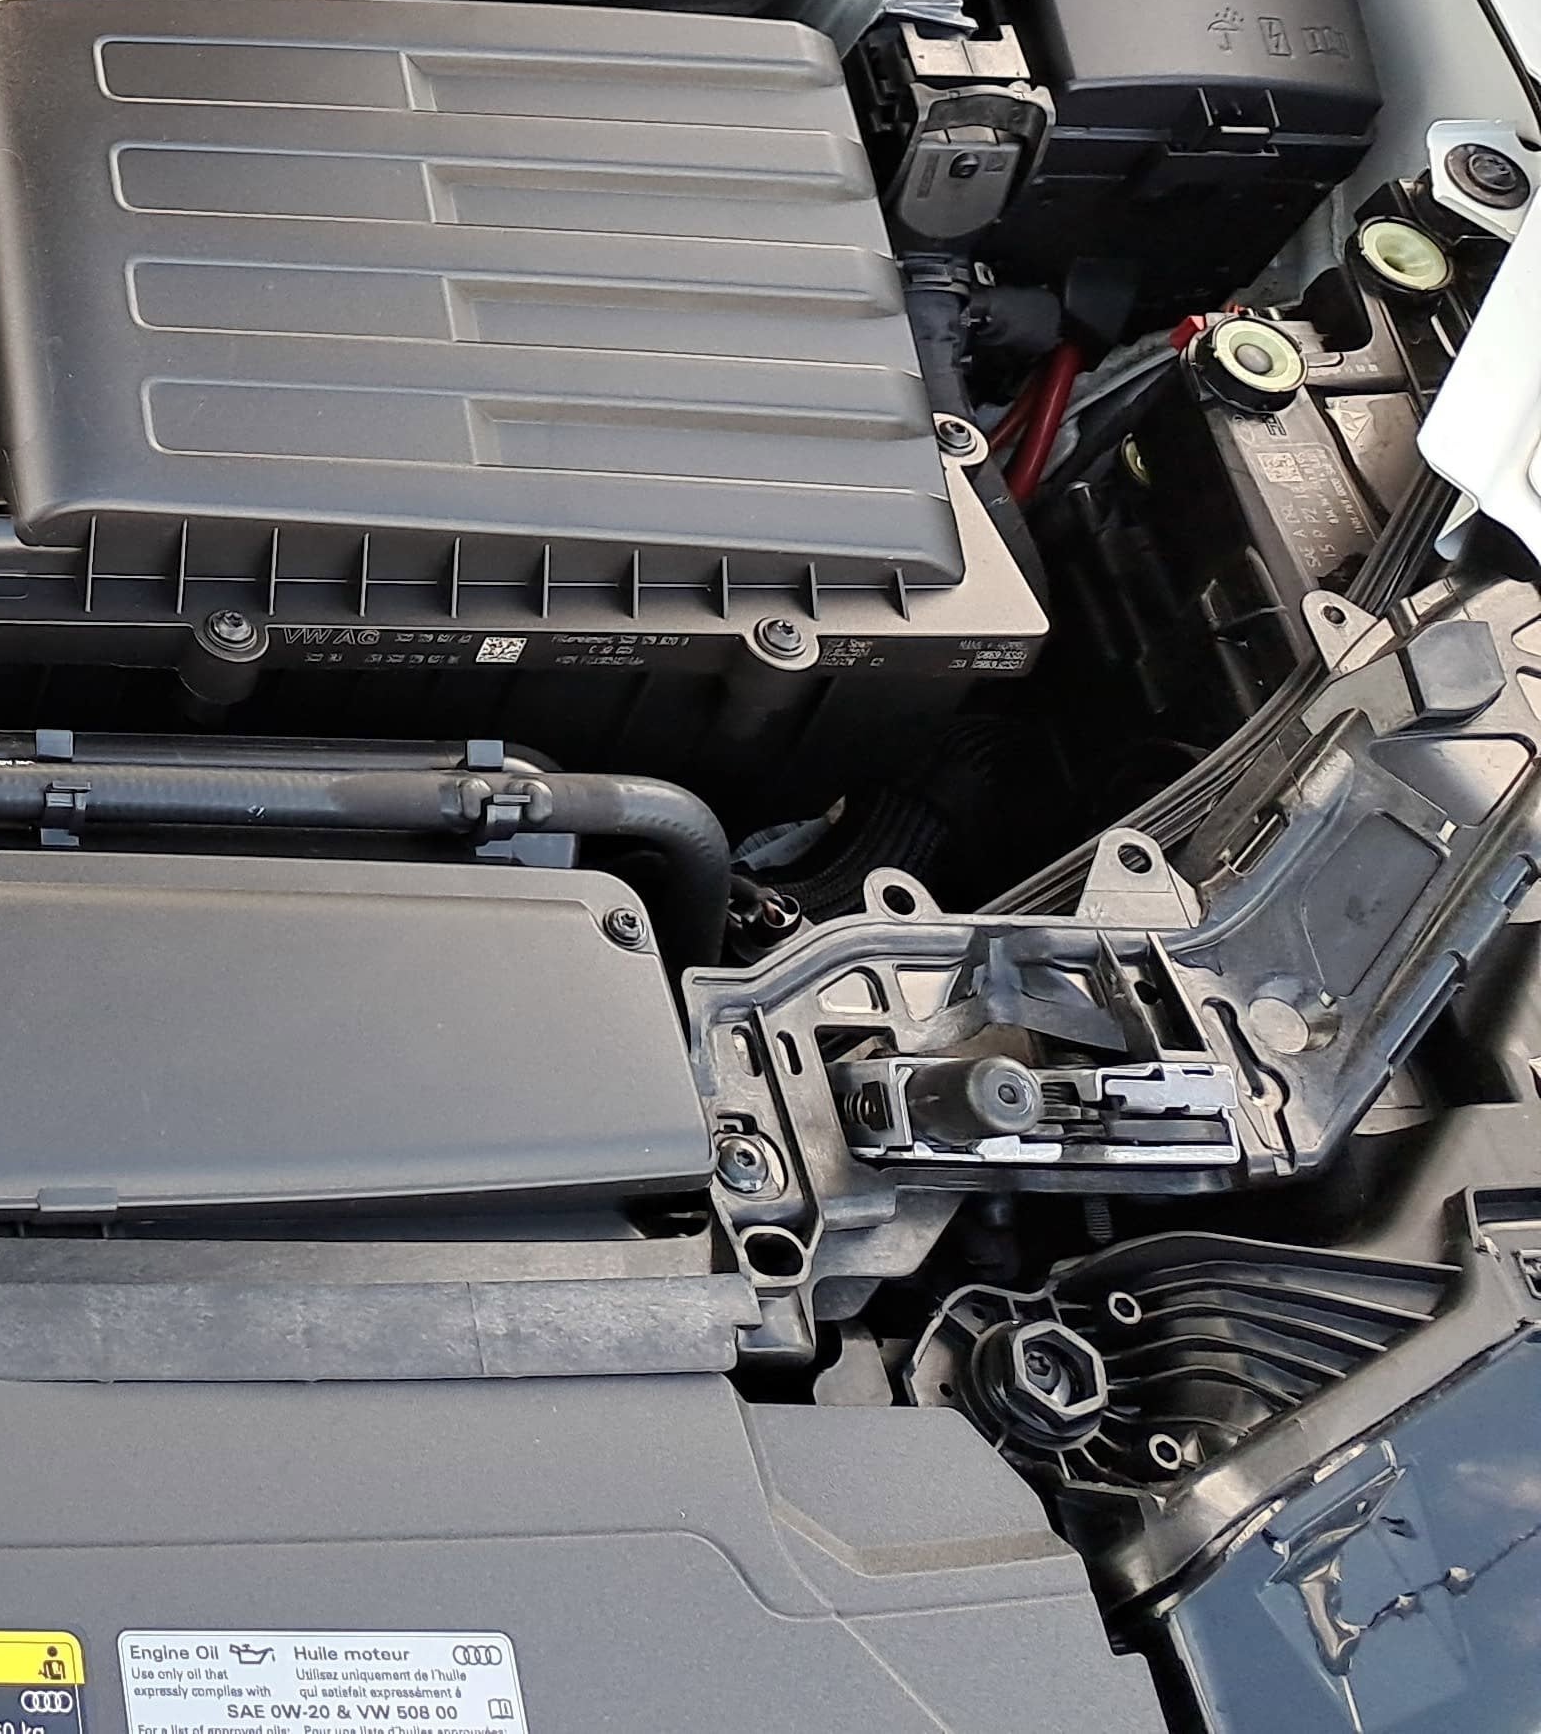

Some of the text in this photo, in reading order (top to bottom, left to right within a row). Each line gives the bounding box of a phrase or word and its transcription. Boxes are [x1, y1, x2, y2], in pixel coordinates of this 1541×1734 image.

[283, 628, 332, 644] VW
[333, 628, 381, 645] AG
[130, 1645, 410, 1662] Engine Oil Huile moteur
[131, 1668, 229, 1682] Use only oil that
[296, 1669, 338, 1681] Utilisez
[341, 1669, 411, 1683] uniquement
[414, 1669, 429, 1681] de
[134, 1685, 271, 1700] expressly complies with
[299, 1687, 317, 1700] qui
[321, 1687, 366, 1698] satisfait
[370, 1687, 452, 1700] expressément
[227, 1704, 458, 1719] SAE 0W-20 & VW 508 00
[137, 1725, 157, 1734] For
[171, 1725, 188, 1734] list
[192, 1725, 204, 1734] of
[304, 1725, 331, 1734] Pour
